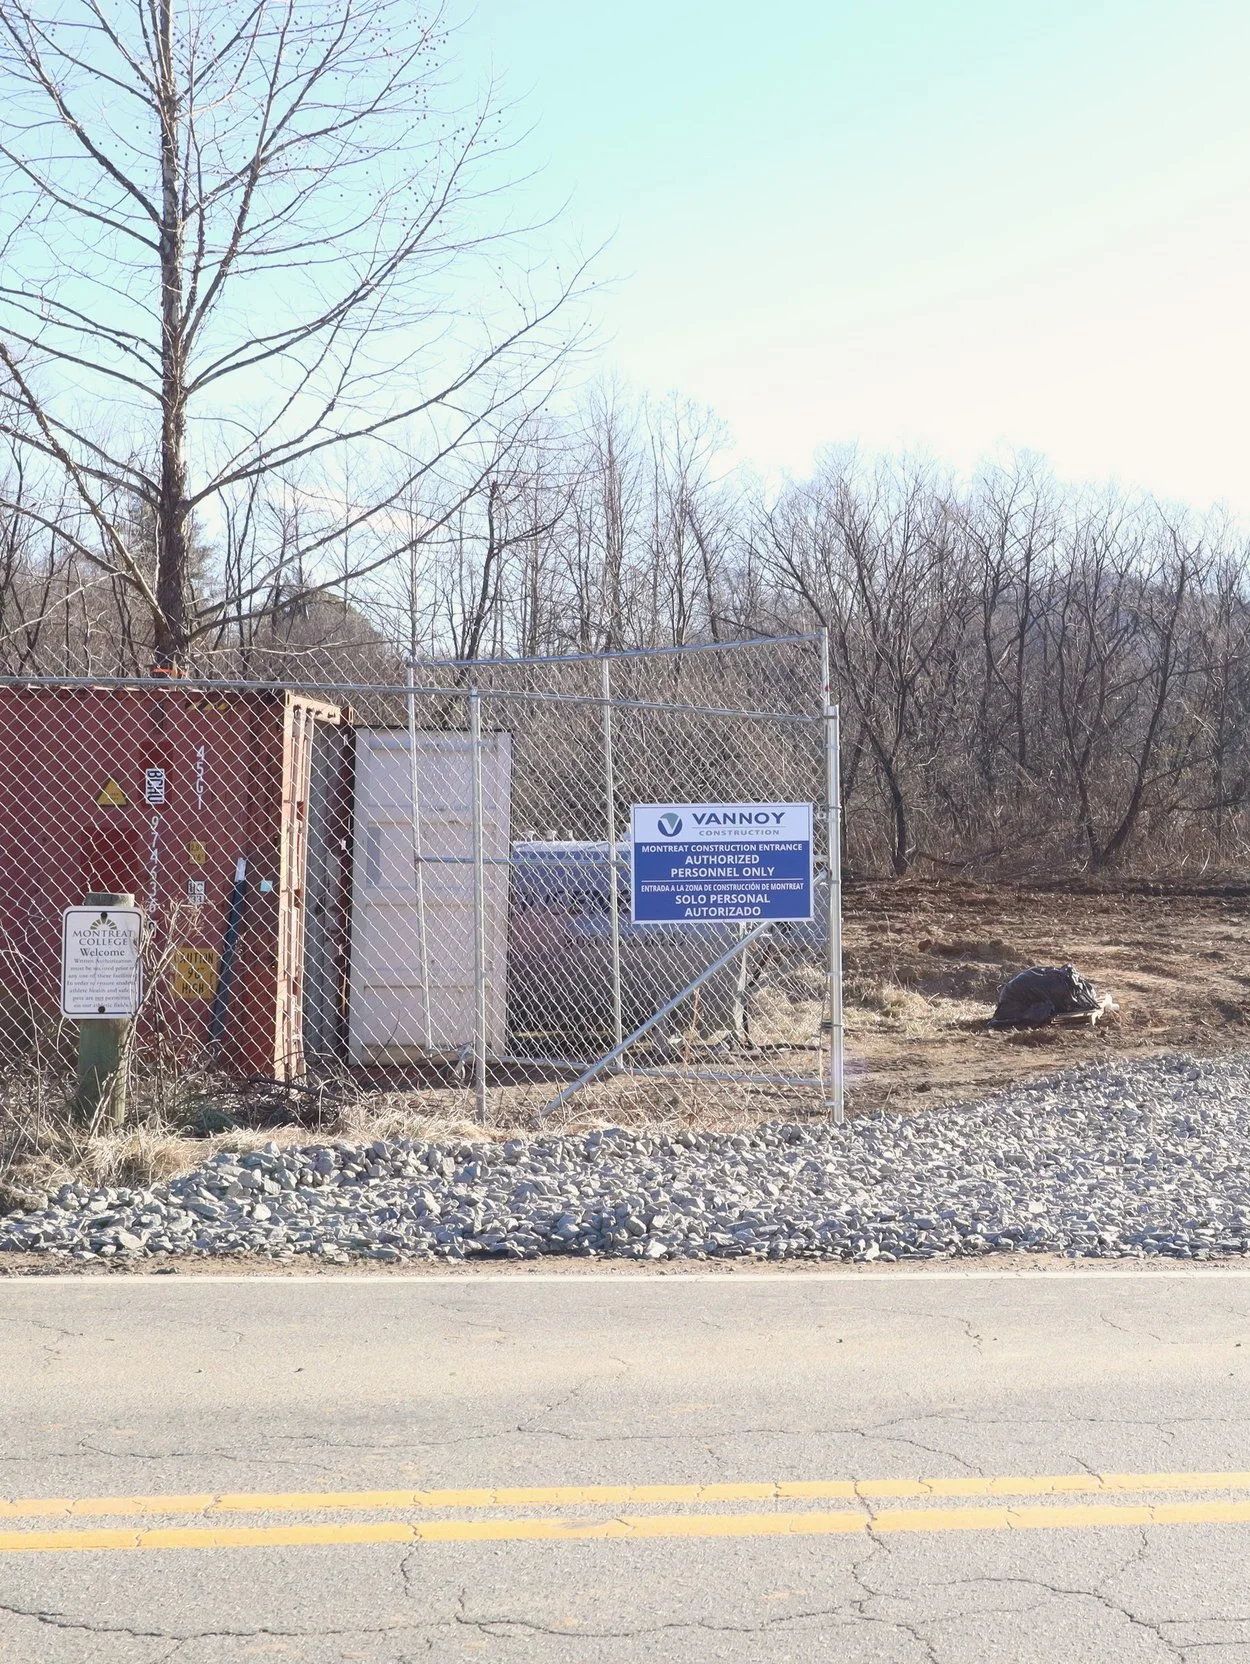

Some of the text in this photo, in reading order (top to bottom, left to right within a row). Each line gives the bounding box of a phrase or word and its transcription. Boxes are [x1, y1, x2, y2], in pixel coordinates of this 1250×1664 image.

[692, 812, 785, 825] VANNOY
[642, 843, 802, 853] MONTREAT CONSTRUCTION ENTRANCE
[685, 855, 759, 864] AUTHORIZED
[671, 867, 775, 877] PERSONNEL ONLY
[641, 884, 670, 892] ENTRADA
[713, 882, 760, 891] CONSTRUCCIÓN
[675, 894, 770, 904] SOLO PERSONAL
[685, 906, 761, 916] AUTORIZADO
[79, 938, 128, 946] COLLEGE
[80, 948, 125, 957] Welcome
